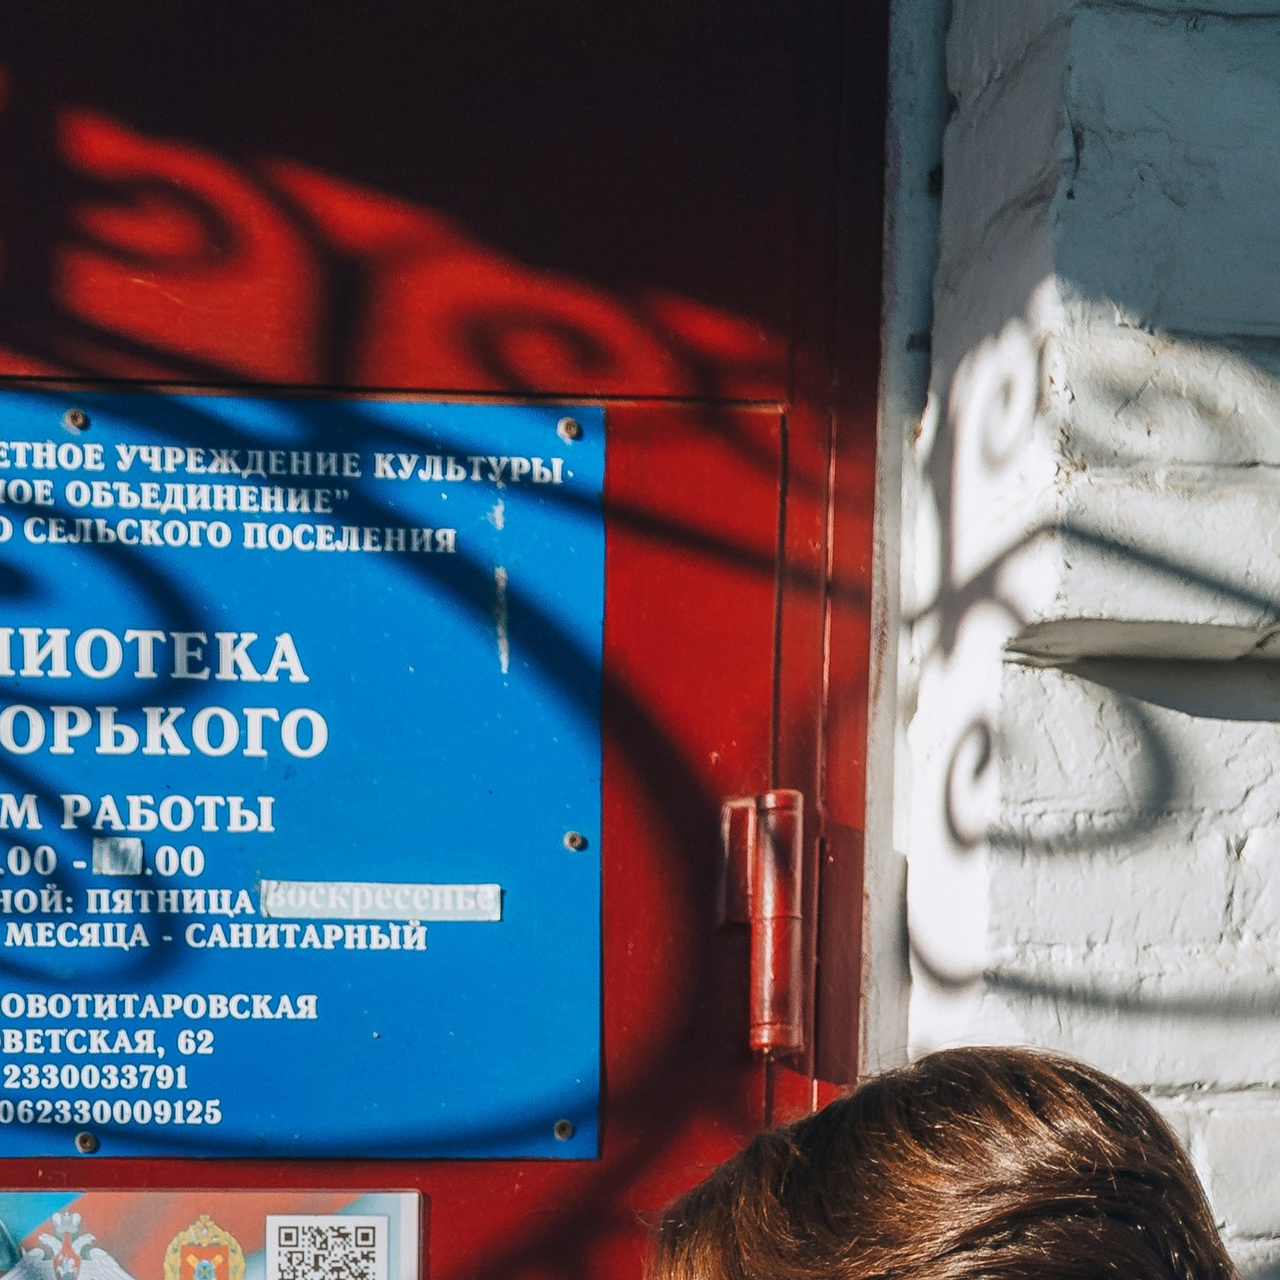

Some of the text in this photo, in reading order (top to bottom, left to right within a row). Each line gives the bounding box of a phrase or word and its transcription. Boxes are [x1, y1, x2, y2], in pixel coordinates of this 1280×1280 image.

[116, 444, 361, 479] УЧРЕЖДЕНИЕ
[24, 516, 231, 548] СЕЛЬСКОГО
[243, 522, 457, 554] ПОСЕЛЕНИЯ
[61, 794, 276, 833] РАБОТЫ
[86, 889, 256, 918] ПЯТНИЦА
[4, 922, 150, 951] МЕСЯЦА
[184, 920, 428, 951] САНИТАРНЫЙ
[178, 1030, 215, 1055] 62
[3, 1065, 188, 1090] 2330033791
